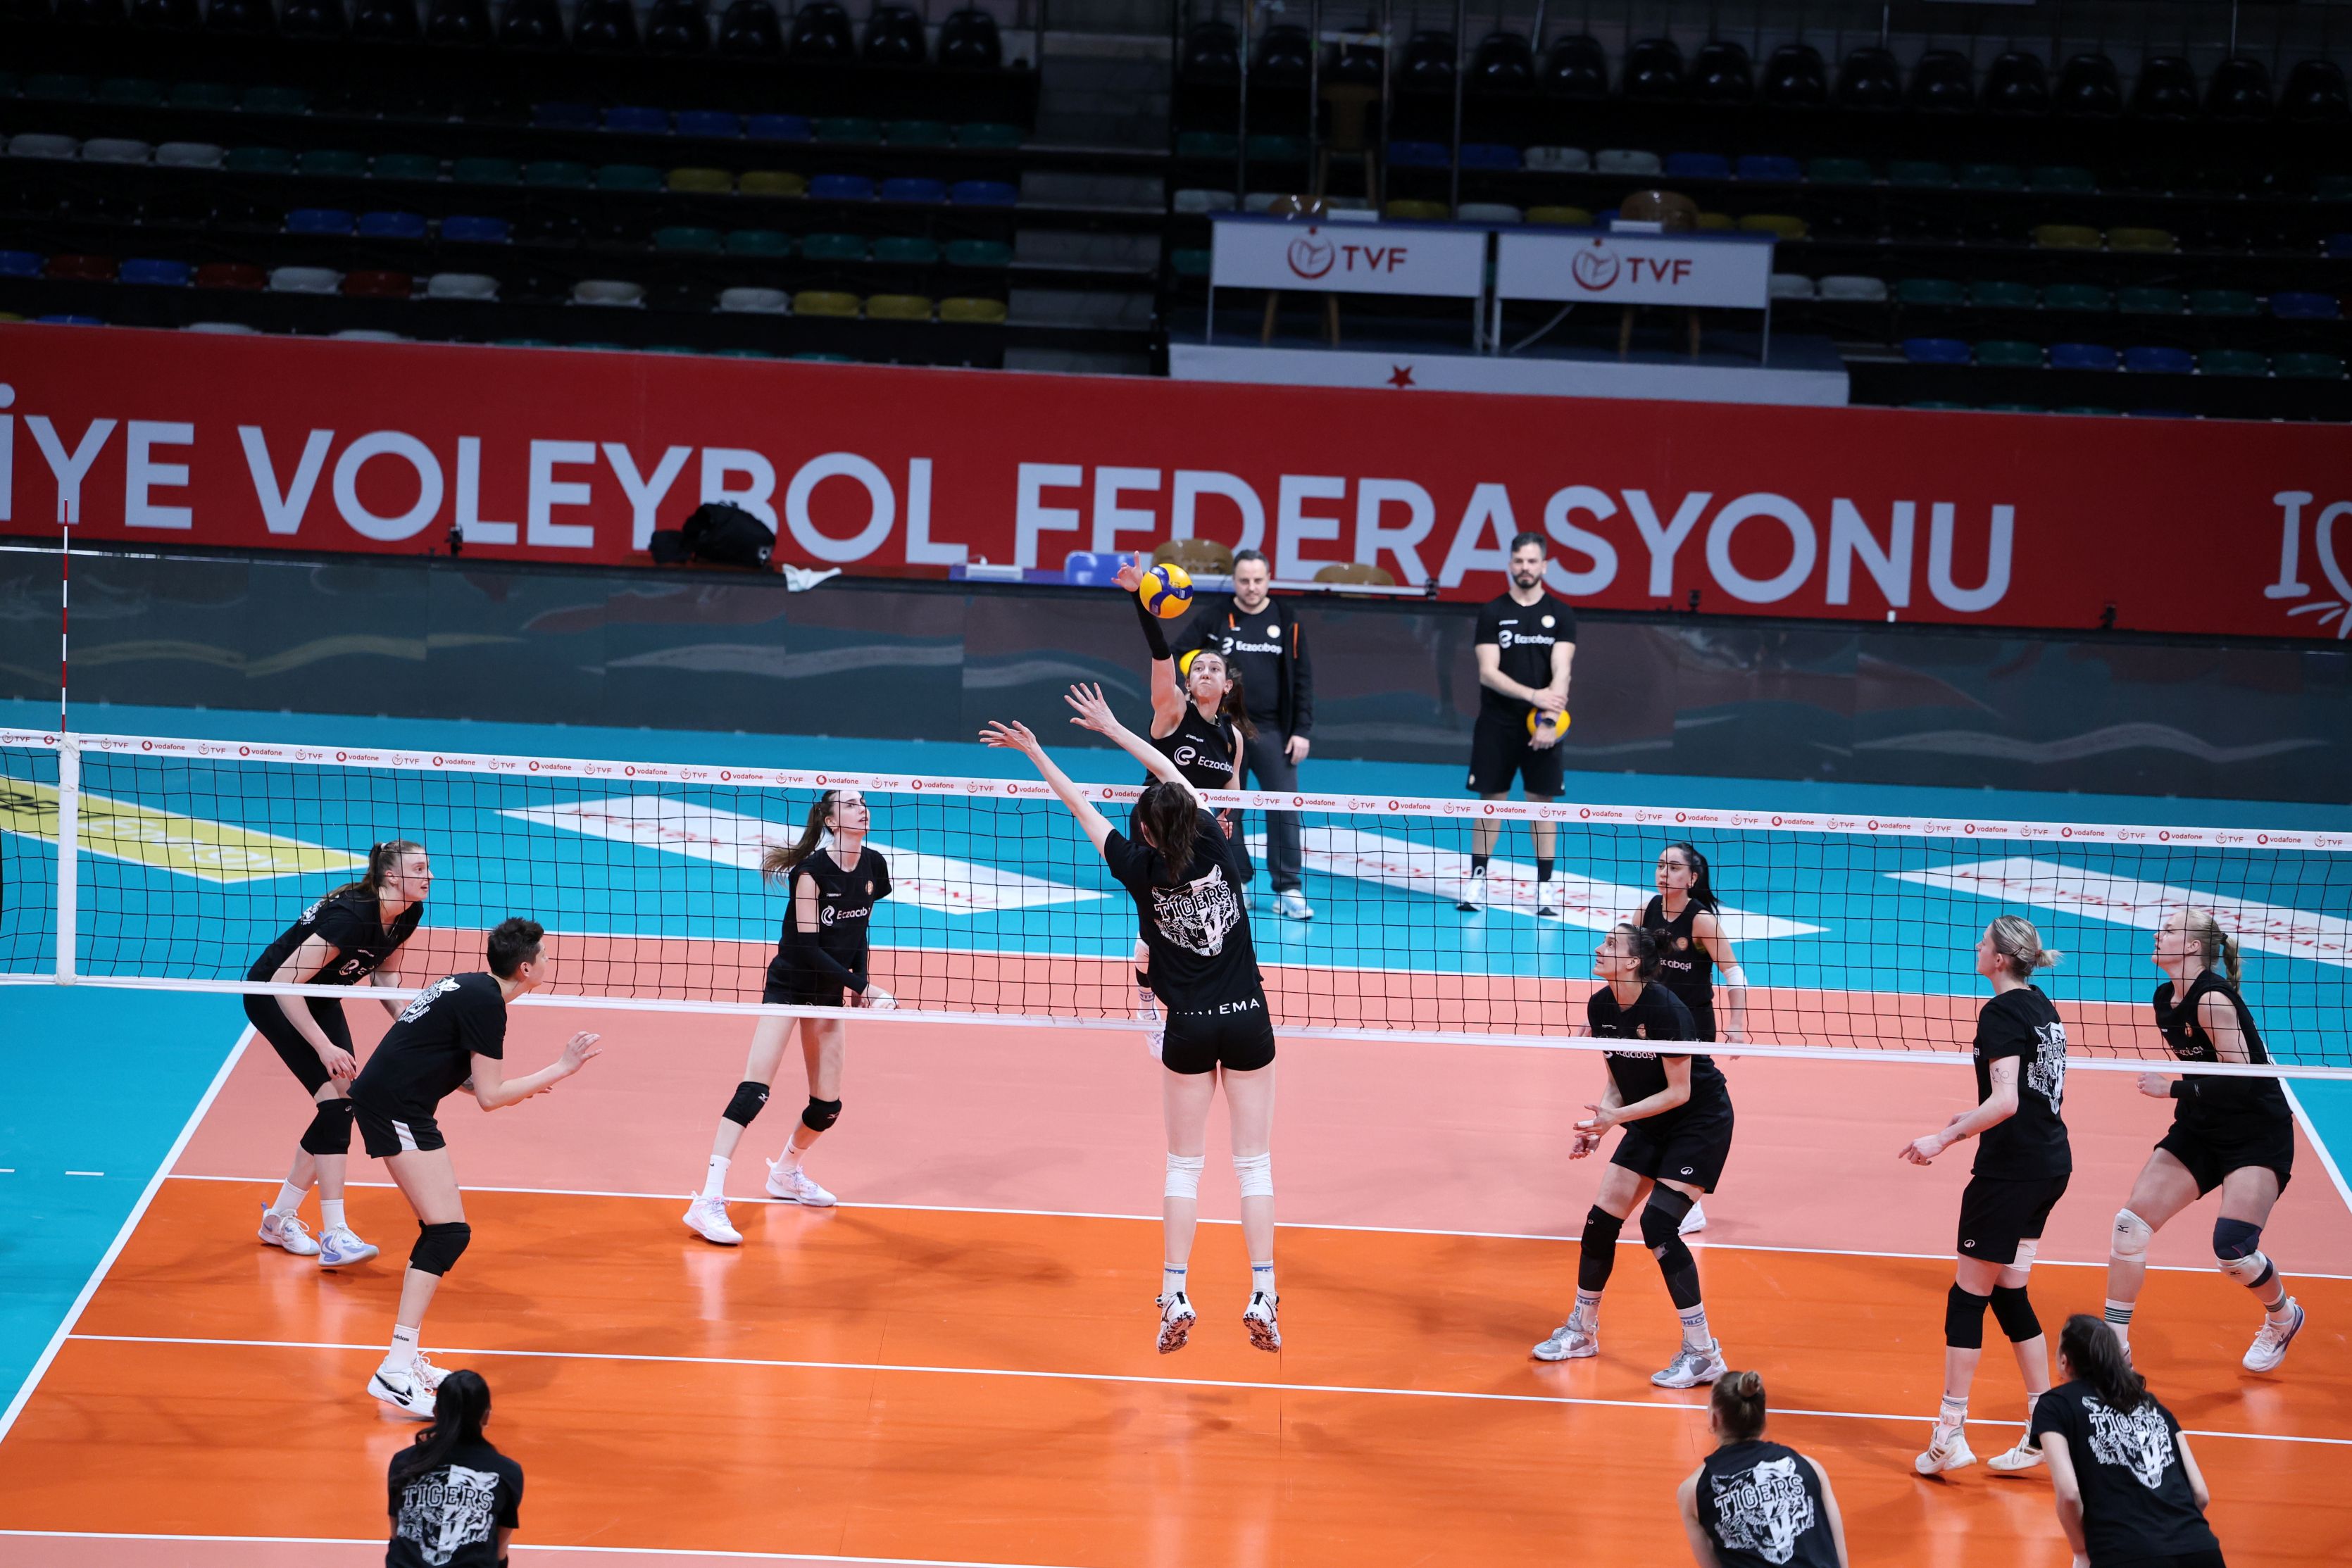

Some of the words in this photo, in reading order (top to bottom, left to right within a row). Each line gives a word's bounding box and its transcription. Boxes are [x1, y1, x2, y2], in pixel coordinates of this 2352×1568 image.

[1341, 245, 1407, 273] TVF
[1627, 257, 1692, 285] TVF
[238, 426, 968, 564] VOLEYBOL
[1015, 463, 2014, 612] FEDERASYONU
[154, 742, 186, 751] vodafone
[251, 748, 283, 756] vodafone
[348, 753, 380, 762] vodafone
[444, 758, 477, 767] vodafone
[541, 763, 573, 771] vodafone
[637, 767, 668, 776] vodafone
[732, 772, 764, 780] vodafone
[828, 777, 860, 785] vodafone
[924, 781, 955, 789] vodafone
[1019, 785, 1050, 794] vodafone
[1209, 794, 1241, 802] vodafone
[1305, 798, 1337, 806] vodafone
[1400, 802, 1432, 810] vodafone
[1496, 806, 1527, 815] vodafone
[1591, 810, 1623, 818] vodafone
[1687, 814, 1719, 822] vodafone
[1784, 818, 1815, 827] vodafone
[1880, 822, 1912, 830] vodafone
[1977, 825, 2008, 834] vodafone
[2073, 829, 2106, 837] vodafone
[2171, 832, 2203, 841] vodafone
[2270, 835, 2302, 843] vodafone
[1154, 880, 1230, 920] TIGERS
[2089, 1413, 2169, 1436] TIGERS
[402, 1483, 495, 1512] TIGERS
[1714, 1474, 1806, 1519] TIGERS
